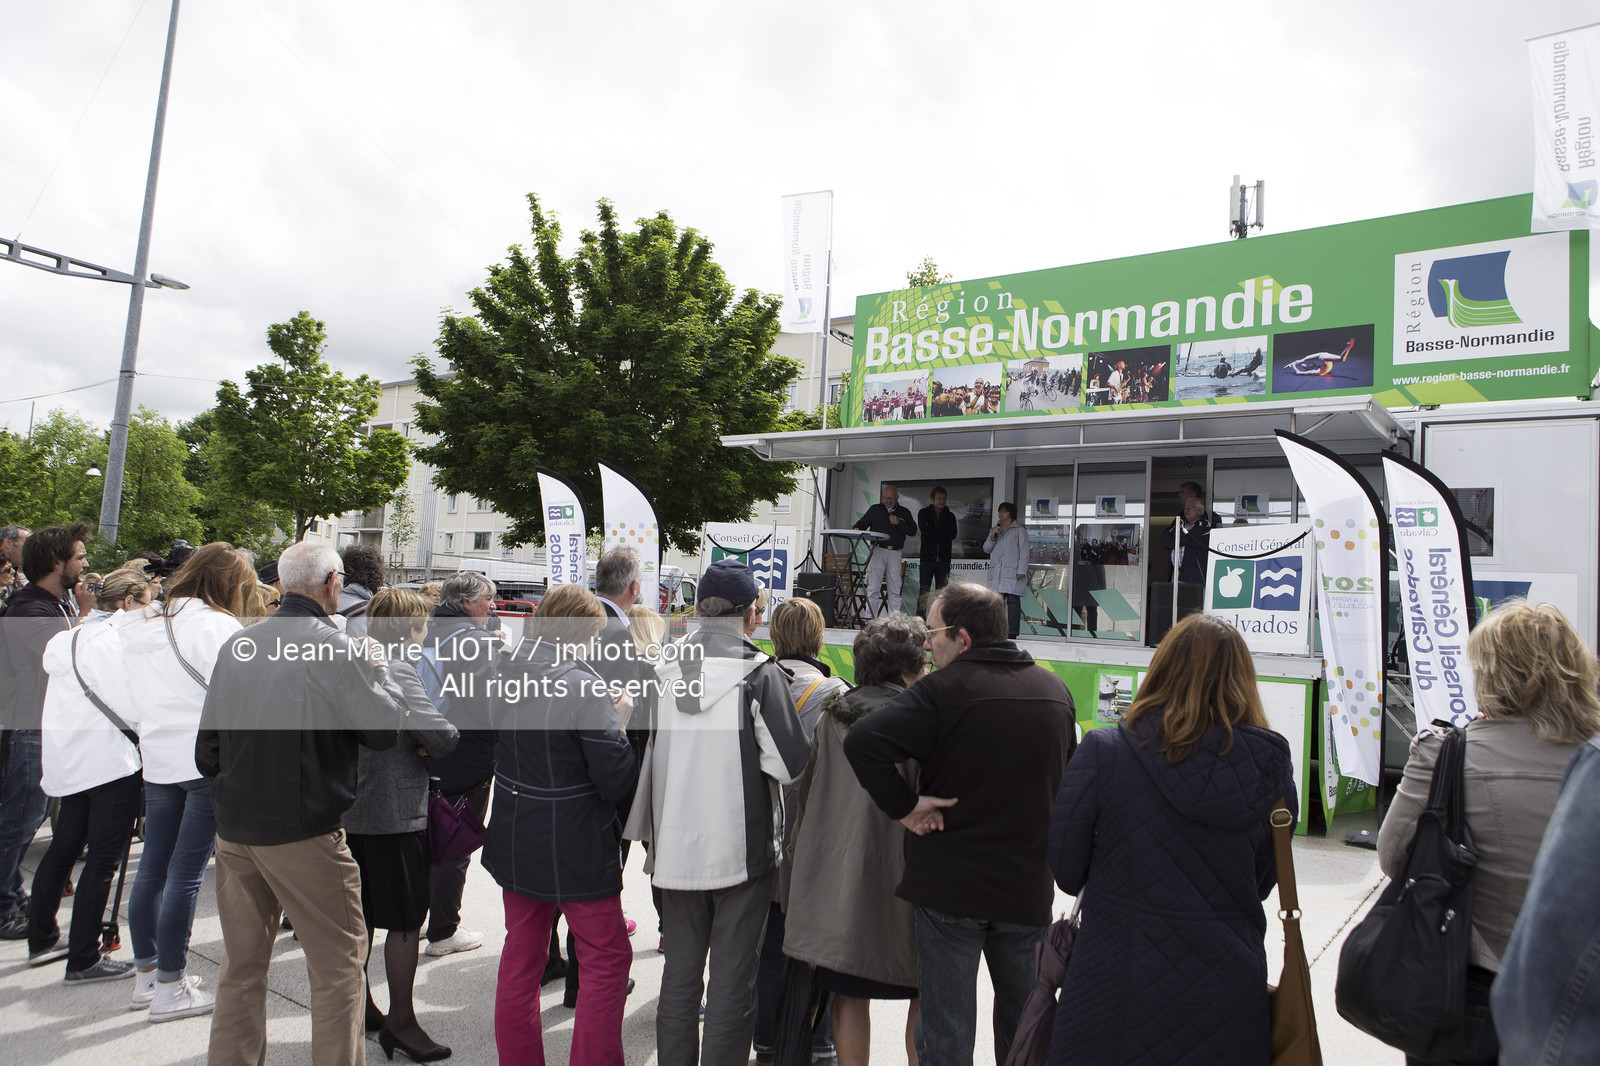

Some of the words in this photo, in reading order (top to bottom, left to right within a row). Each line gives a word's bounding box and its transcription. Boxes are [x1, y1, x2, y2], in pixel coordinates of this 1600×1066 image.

[891, 291, 1014, 325] Région
[1406, 261, 1426, 335] Région
[864, 278, 1313, 368] Basse-Normandie
[1405, 327, 1556, 354] Basse-Normandie
[1392, 363, 1571, 386] www.region-basse-normandie.fr
[713, 532, 750, 543] Conseil
[1216, 539, 1258, 552] Conseil
